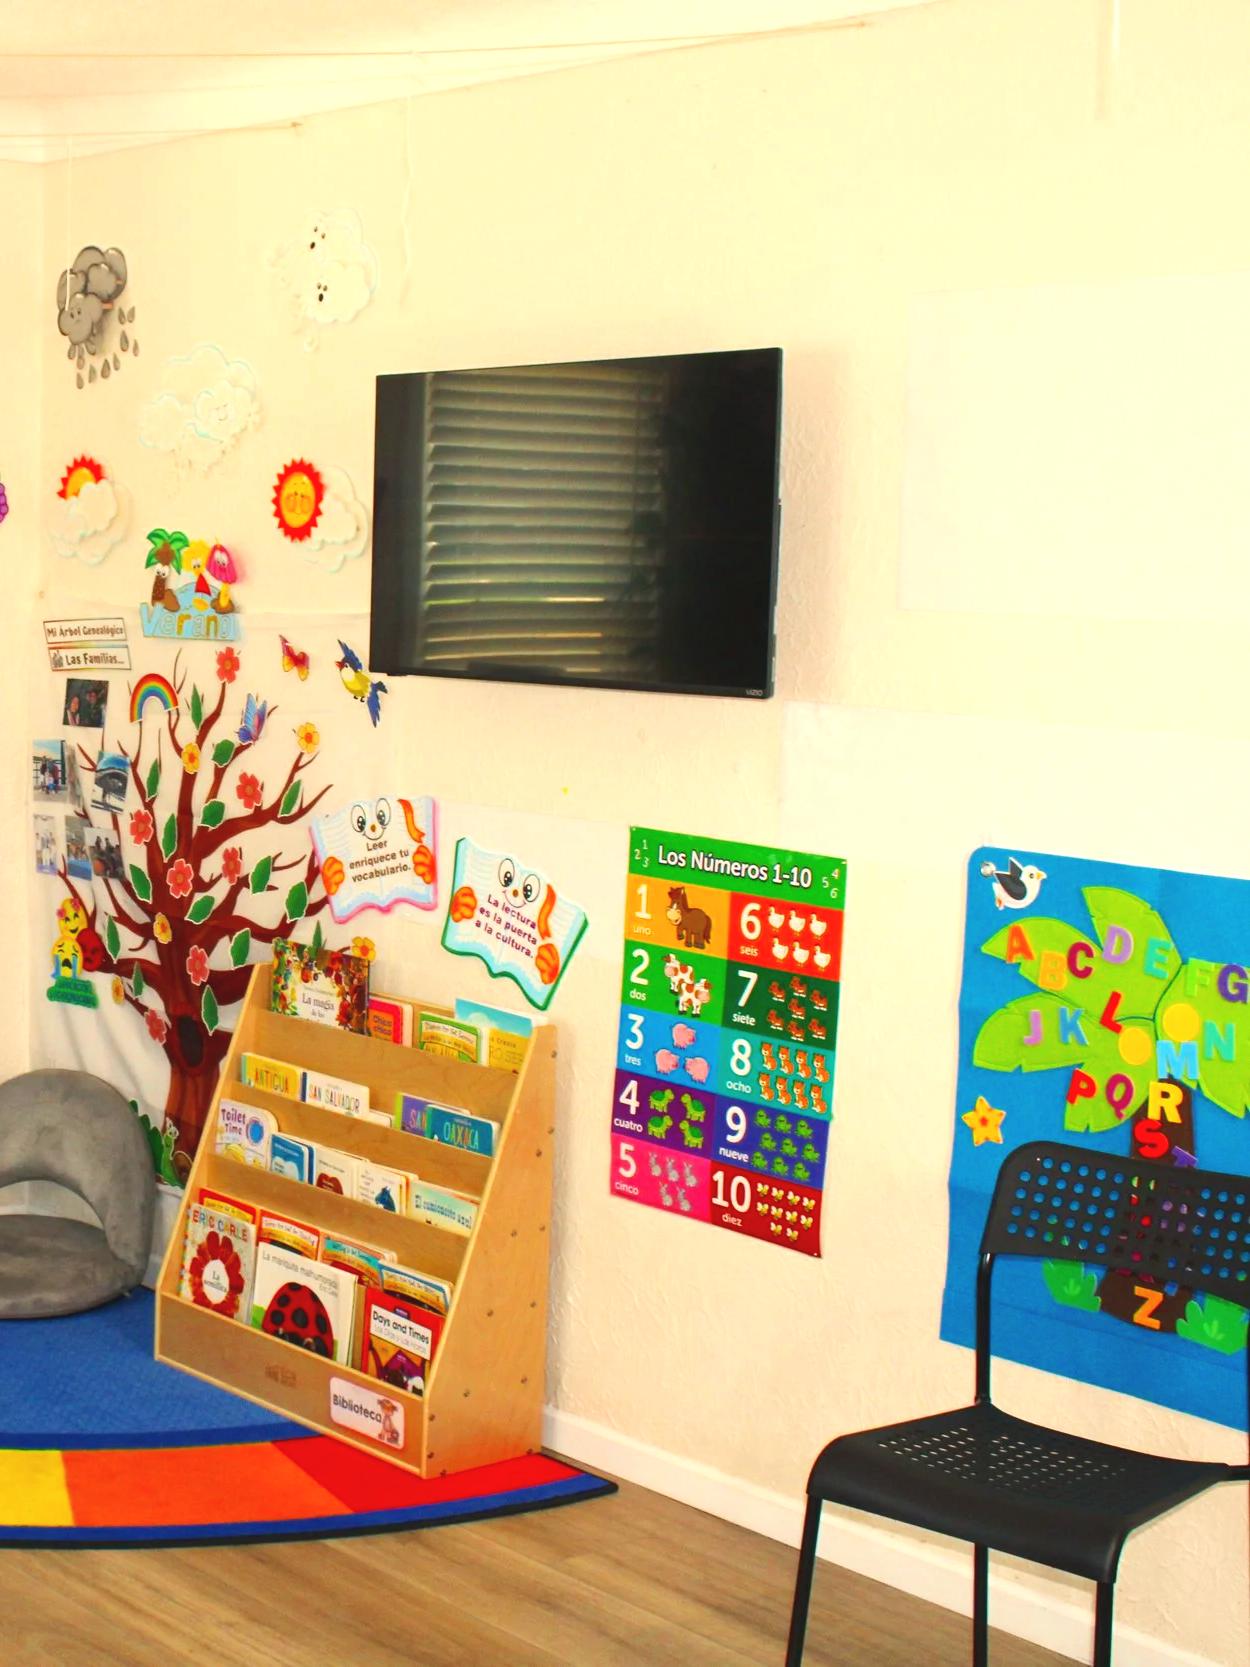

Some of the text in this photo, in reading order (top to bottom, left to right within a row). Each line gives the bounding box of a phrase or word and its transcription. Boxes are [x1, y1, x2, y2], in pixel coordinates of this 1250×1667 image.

[46, 624, 124, 638] Mi Árbol Genealógico
[140, 602, 230, 638] Verano
[65, 653, 81, 666] Las
[349, 848, 410, 870] enriquece tu
[366, 839, 388, 852] Leer
[634, 849, 641, 860] 2
[642, 839, 648, 850] 1
[351, 862, 411, 883] vocabulario.
[642, 857, 649, 868] 3
[658, 845, 813, 888] Los Números 1-10
[831, 868, 840, 879] 4
[821, 877, 830, 888] 5
[830, 888, 838, 899] 6
[487, 893, 537, 930] La lectura
[635, 884, 651, 919] 1
[479, 906, 537, 945] es la puerta
[633, 924, 651, 936] uno
[740, 903, 761, 940] 6
[475, 919, 534, 959] a la cultura.
[740, 945, 758, 956] seis
[1102, 924, 1174, 980] D E
[630, 949, 650, 985] 2
[1006, 924, 1094, 991] A B C
[629, 989, 647, 1001] dos
[738, 970, 758, 1007] 7
[1184, 957, 1249, 1004] F G
[302, 993, 312, 1005] La
[1100, 990, 1123, 1034] L
[625, 1013, 644, 1050] 3
[732, 1012, 756, 1026] siete
[1023, 1006, 1090, 1046] J K
[624, 1054, 641, 1065] tres
[730, 1038, 752, 1076] 8
[1156, 1020, 1235, 1080] M N
[254, 1067, 290, 1094] ANTIGUA
[726, 1080, 752, 1094] ocho
[1066, 1067, 1134, 1121] P Q
[309, 1083, 322, 1101] SAN
[325, 1089, 360, 1114] SALVADOR
[619, 1080, 640, 1115] 4
[1147, 1080, 1183, 1124] R
[221, 1107, 246, 1124] Toilet
[225, 1122, 242, 1135] Time
[614, 1117, 643, 1133] cuatro
[725, 1106, 746, 1143] 9
[444, 1121, 478, 1150] OAXACA
[1134, 1118, 1169, 1159] S
[618, 1142, 637, 1178] 5
[719, 1146, 750, 1162] nueve
[415, 1194, 422, 1208] El
[614, 1180, 639, 1195] cinco
[711, 1170, 751, 1213] 10
[193, 1209, 215, 1228] ERIC
[217, 1219, 248, 1242] CARLE
[722, 1212, 742, 1227] diez
[262, 1250, 270, 1260] La
[1133, 1285, 1164, 1330] Z
[373, 1311, 429, 1344] Days and Times
[333, 1394, 382, 1423] Biblioteca
